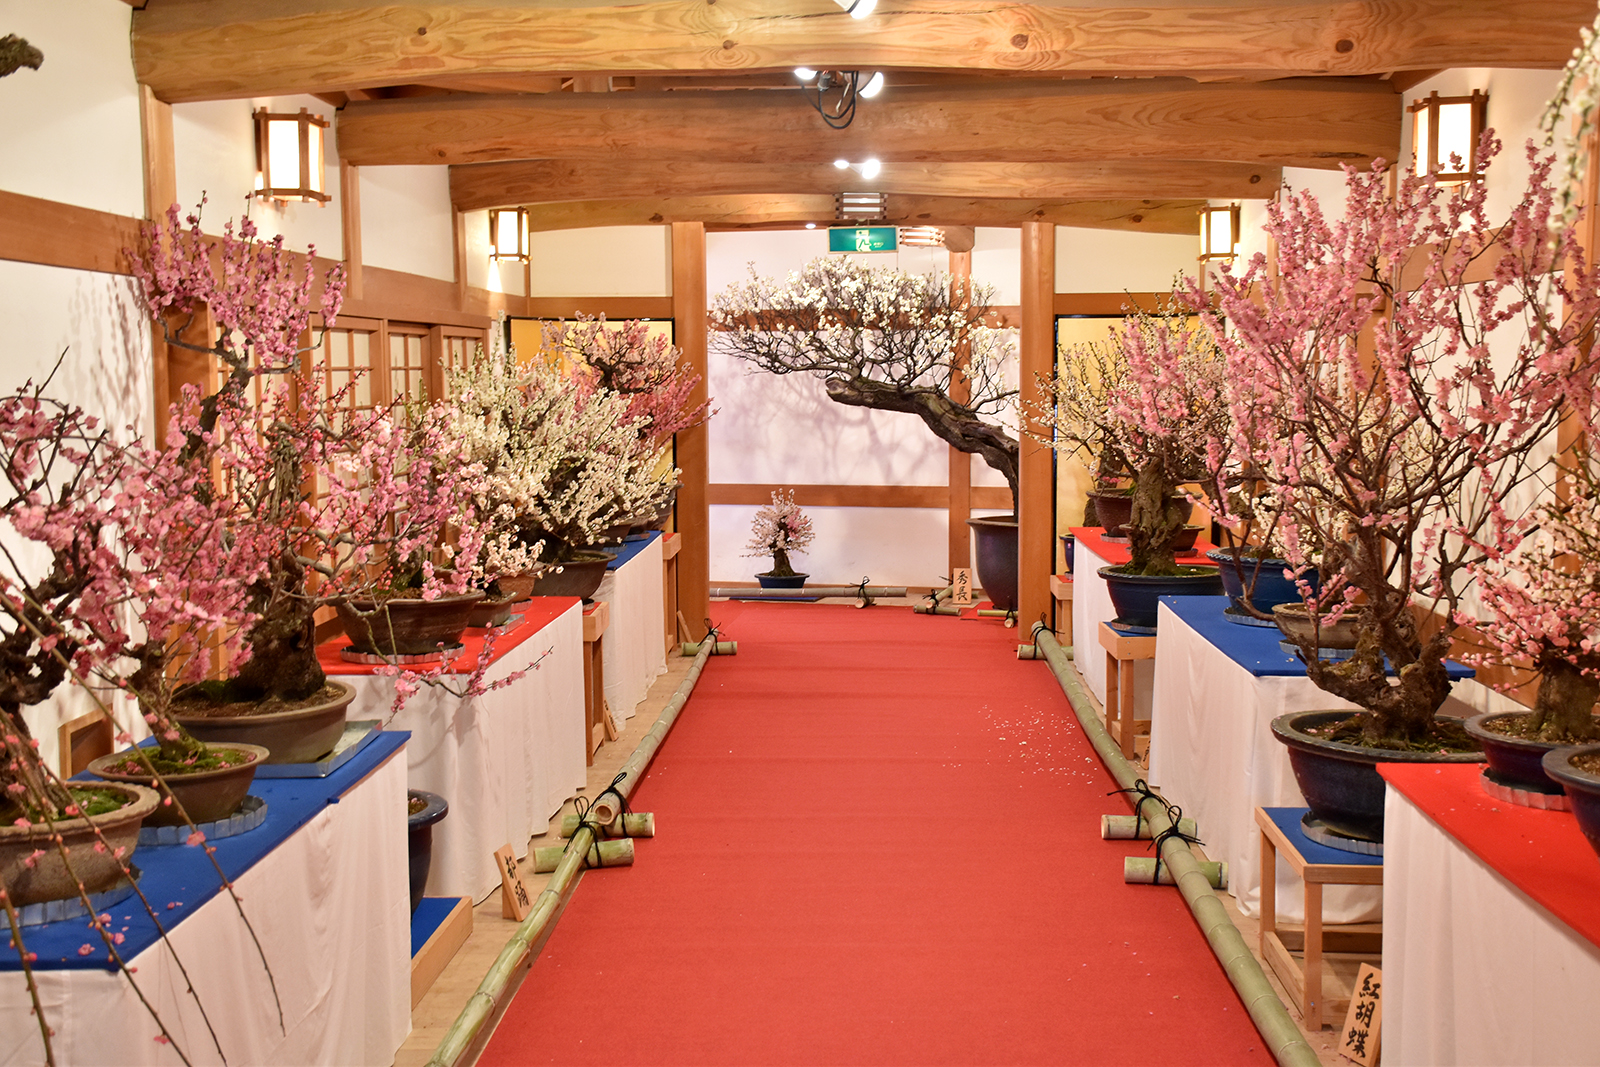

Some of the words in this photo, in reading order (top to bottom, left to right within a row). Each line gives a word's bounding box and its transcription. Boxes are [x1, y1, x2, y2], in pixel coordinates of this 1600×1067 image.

[956, 570, 968, 601] 秀長
[1346, 972, 1381, 1058] 紅胡蝶
